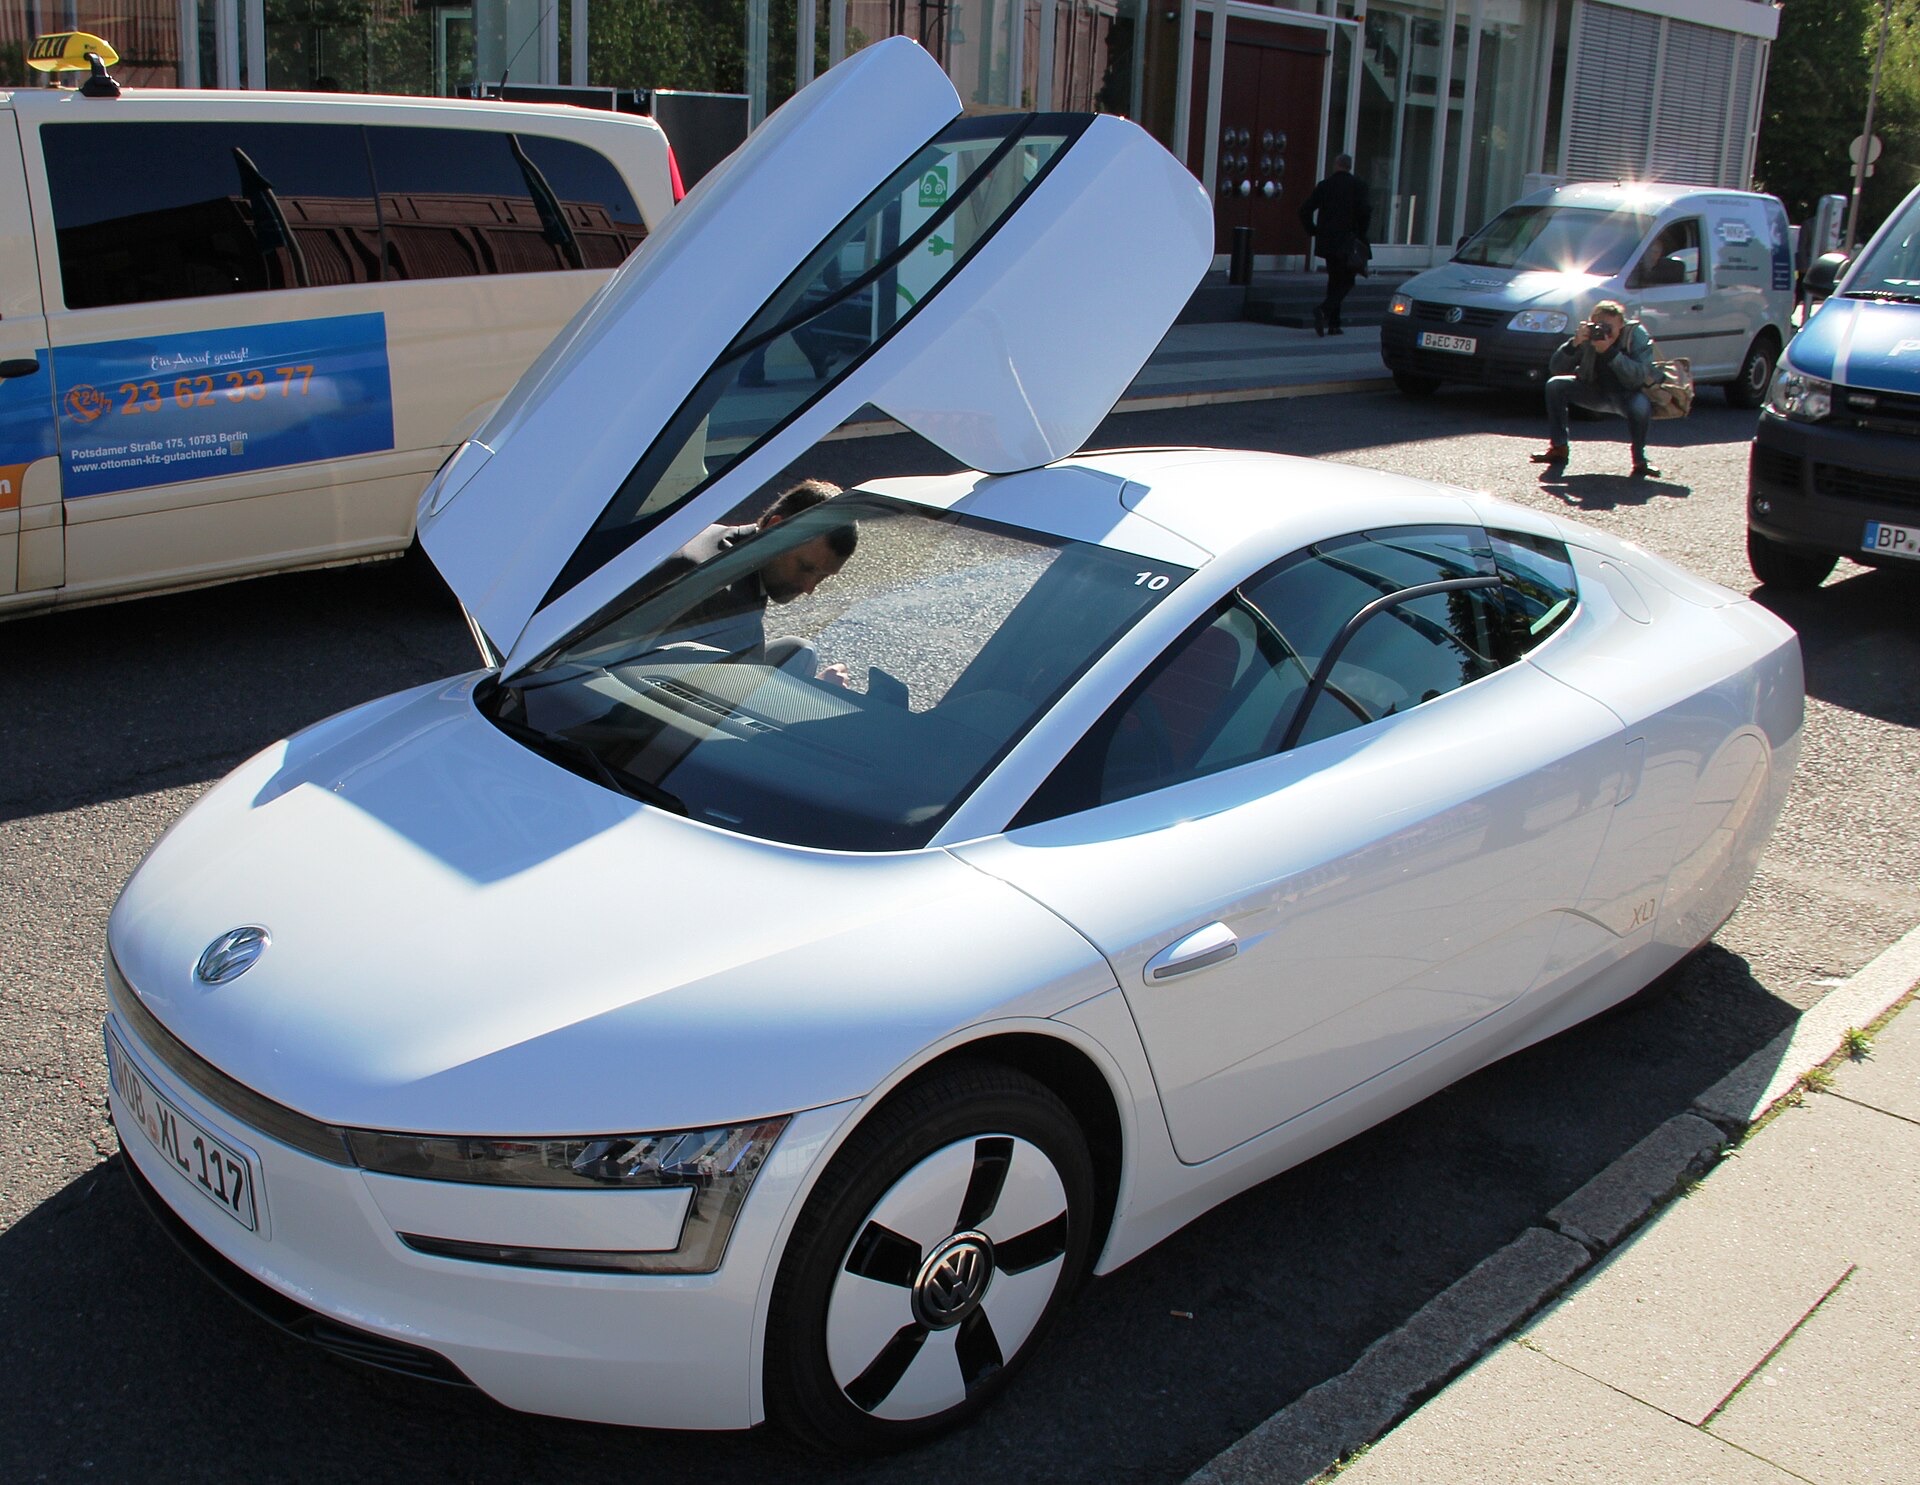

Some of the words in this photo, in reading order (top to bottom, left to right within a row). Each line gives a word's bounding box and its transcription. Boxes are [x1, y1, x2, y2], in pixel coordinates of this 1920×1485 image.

[33, 37, 66, 58] TAXI
[1452, 338, 1472, 351] 378
[151, 354, 171, 371] Ein
[173, 350, 210, 369] Anruf
[214, 347, 249, 365] genügt!
[119, 380, 163, 415] 23
[173, 374, 215, 410] 62
[226, 369, 267, 404] 33
[275, 364, 315, 398] 77
[71, 446, 128, 460] Potsdamer
[129, 440, 163, 454] Straße
[165, 438, 186, 450] 175,
[188, 434, 217, 447] 10783
[219, 431, 249, 443] Berlin
[71, 447, 228, 473] www.ottoman-kfz-gutachten.de
[1134, 571, 1170, 591] 10
[1630, 898, 1656, 929] XL1
[155, 1100, 191, 1173] XL
[193, 1135, 243, 1212] 117
